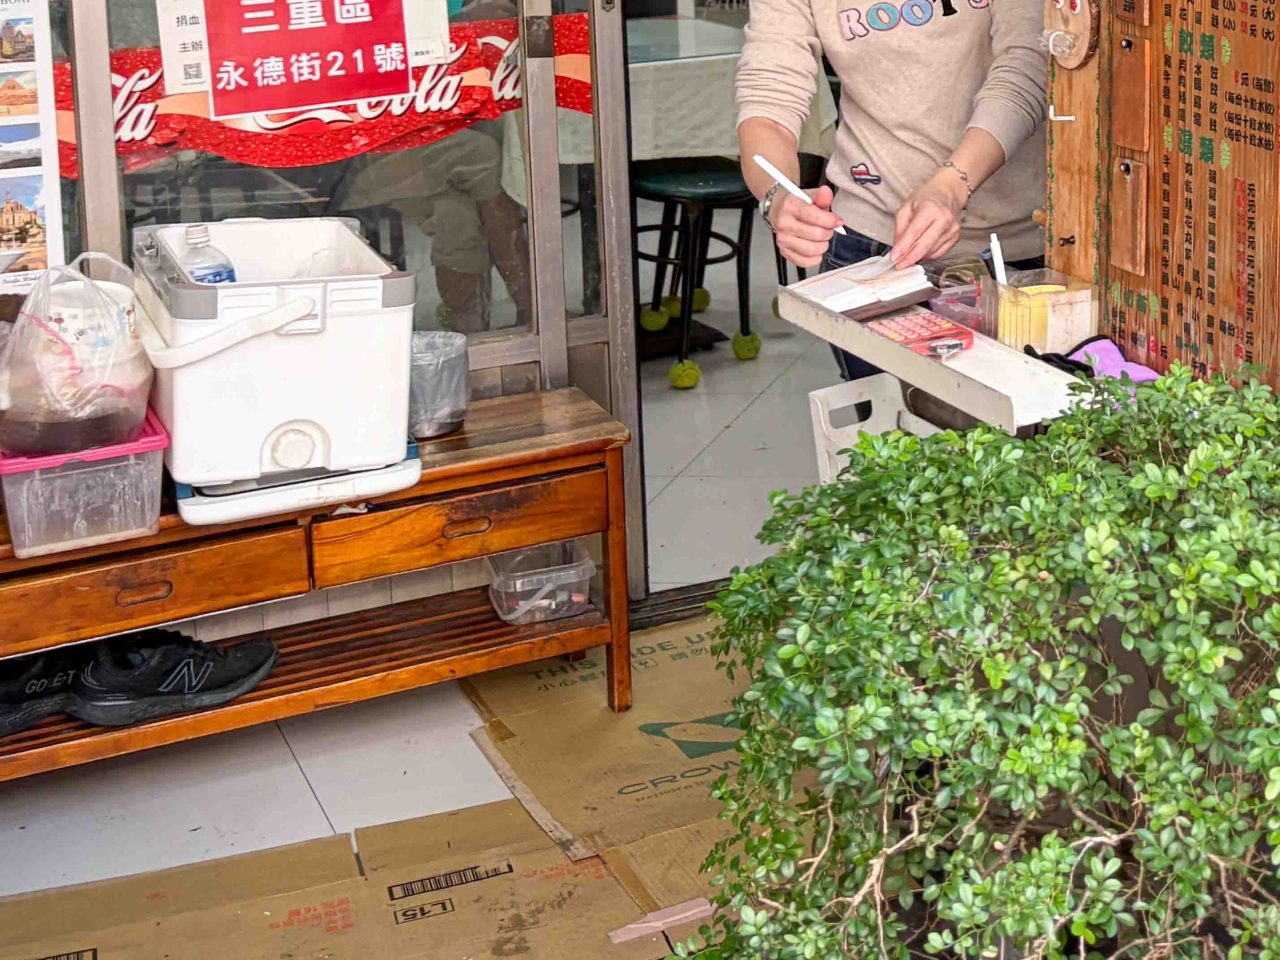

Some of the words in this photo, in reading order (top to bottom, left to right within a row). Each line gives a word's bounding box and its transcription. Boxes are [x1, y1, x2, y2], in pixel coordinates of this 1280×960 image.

[216, 41, 406, 92] 永德街21號
[528, 659, 598, 681] THIS
[617, 760, 741, 796] CROW
[399, 900, 450, 922] L15
